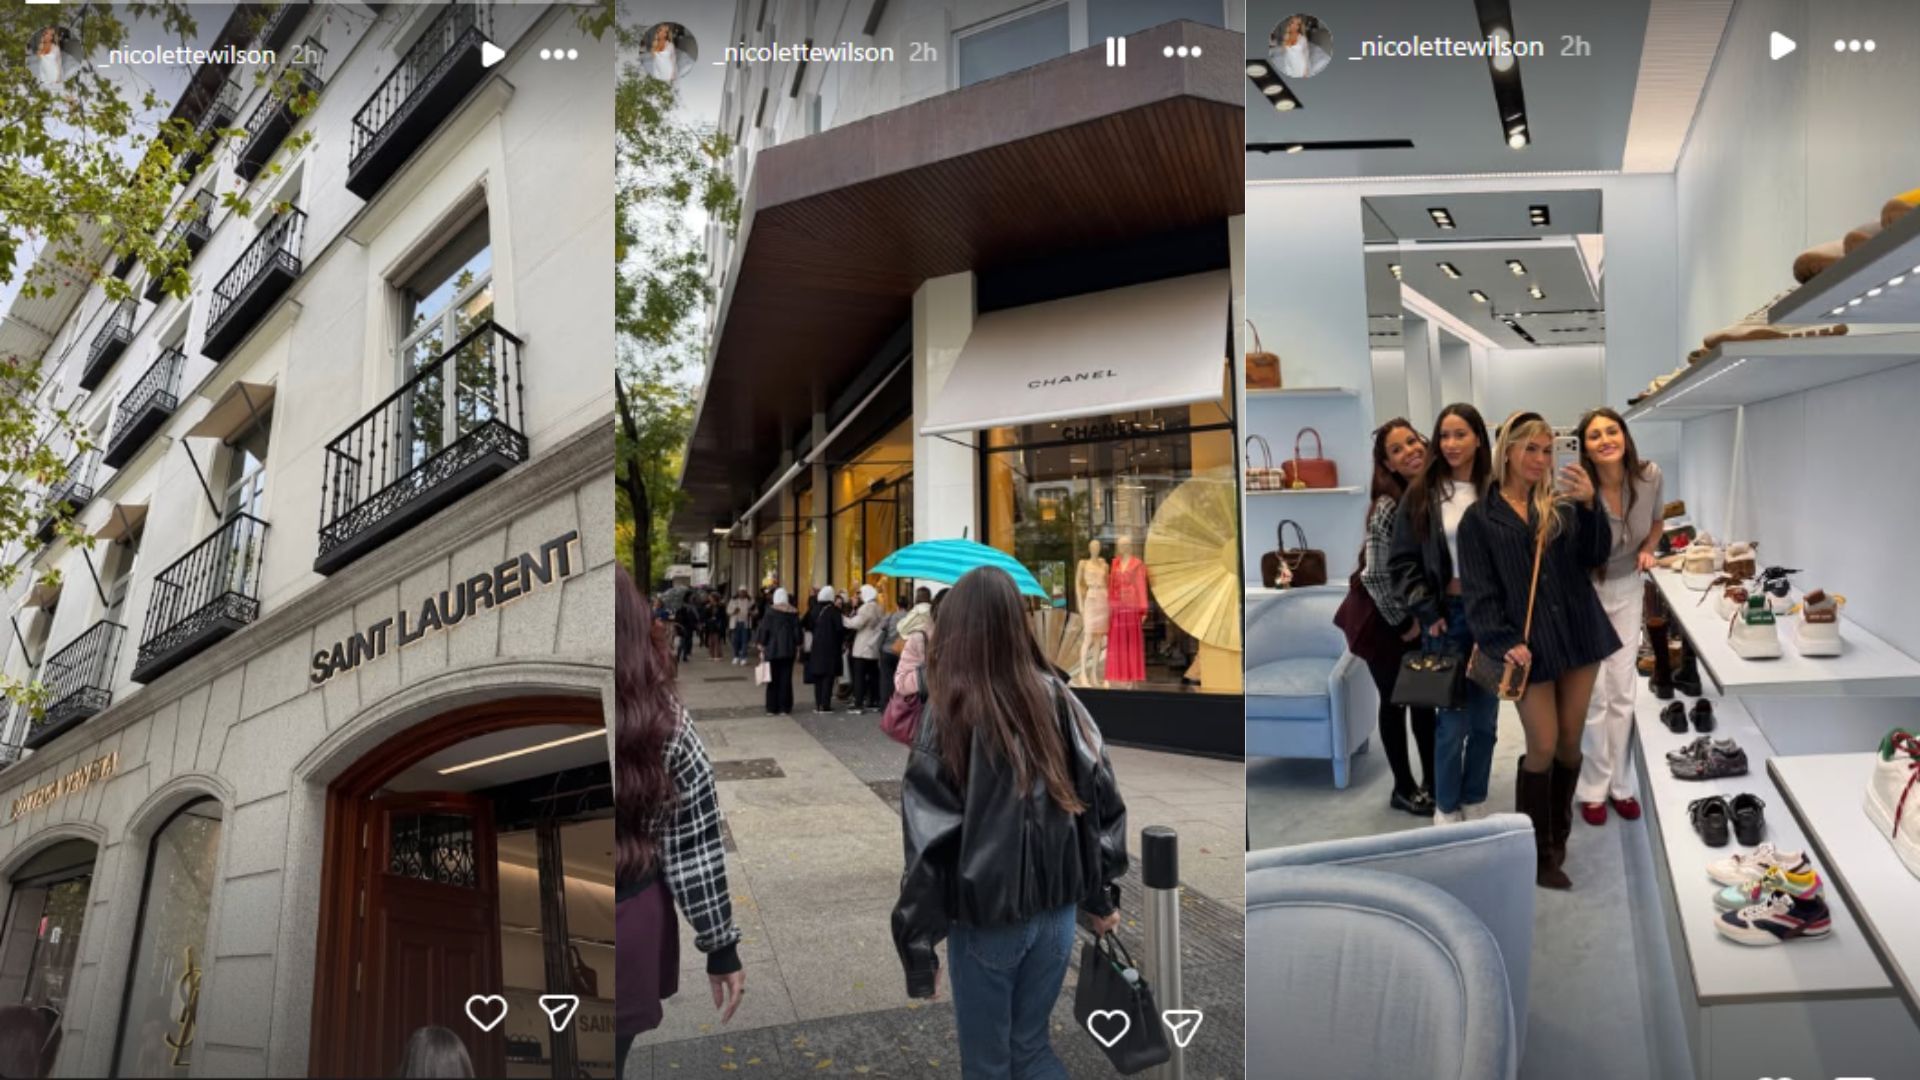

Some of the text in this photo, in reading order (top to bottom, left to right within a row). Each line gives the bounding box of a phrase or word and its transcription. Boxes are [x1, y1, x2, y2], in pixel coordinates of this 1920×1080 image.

[1027, 369, 1117, 389] CHANEL
[309, 529, 579, 684] SAINT LAURENT
